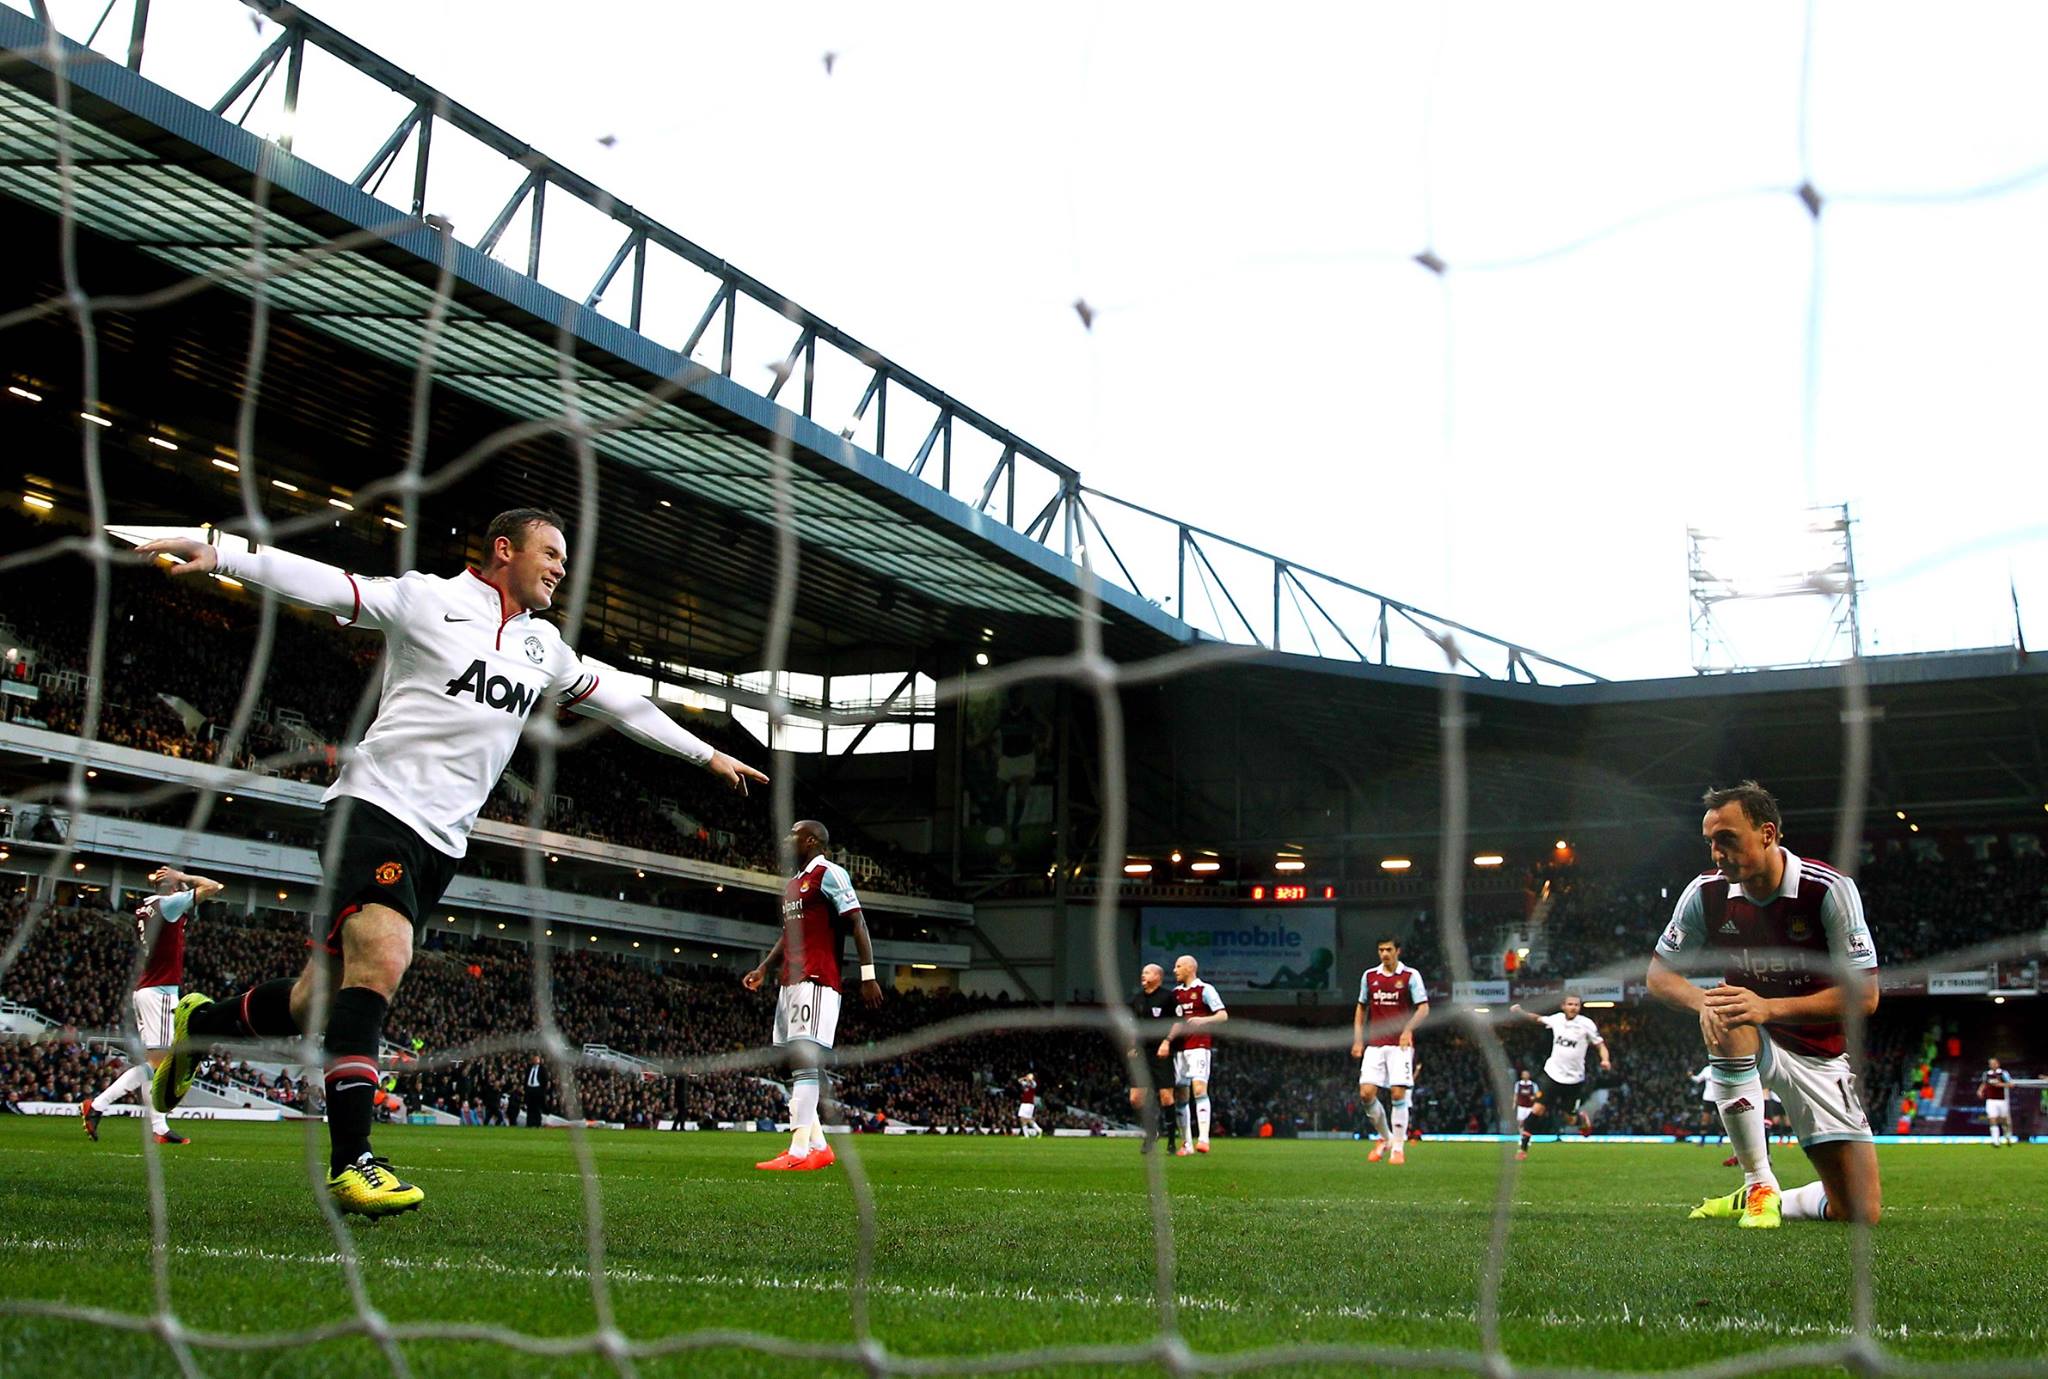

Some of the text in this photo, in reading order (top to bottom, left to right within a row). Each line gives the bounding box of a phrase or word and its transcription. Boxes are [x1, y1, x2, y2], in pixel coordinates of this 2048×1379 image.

[444, 658, 535, 719] AON
[1254, 886, 1263, 899] 0
[1149, 926, 1302, 950] Lycamobile
[790, 1003, 811, 1024] 20
[1555, 1035, 1578, 1049] AON
